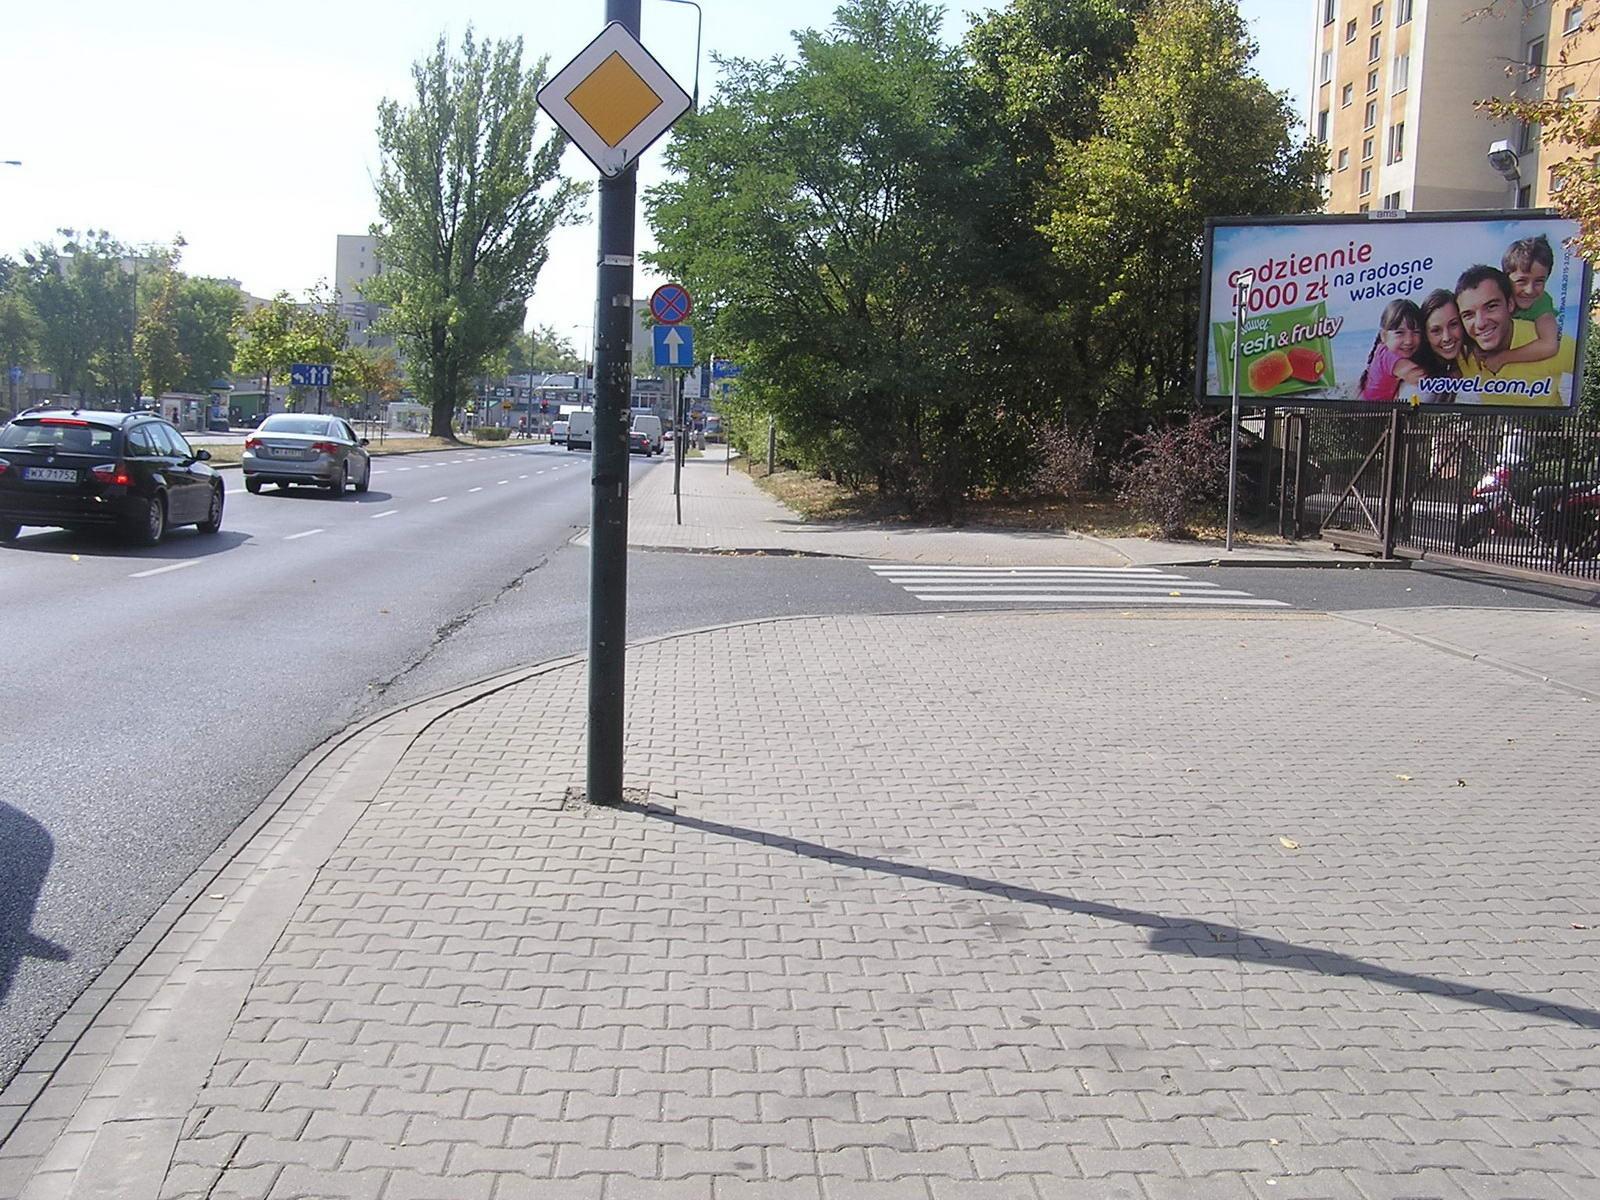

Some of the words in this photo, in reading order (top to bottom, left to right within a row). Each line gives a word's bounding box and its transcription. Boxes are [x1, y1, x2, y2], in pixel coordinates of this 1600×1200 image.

[1334, 272, 1354, 287] na
[1359, 257, 1433, 282] radosne
[1232, 281, 1298, 317] 000
[1305, 274, 1329, 302] zł
[1350, 275, 1424, 302] wakacje
[1277, 331, 1289, 347] &
[1290, 316, 1343, 344] fruity
[1419, 376, 1552, 398] wawel.com.pl
[31, 468, 44, 479] WX
[46, 469, 76, 481] 71752
